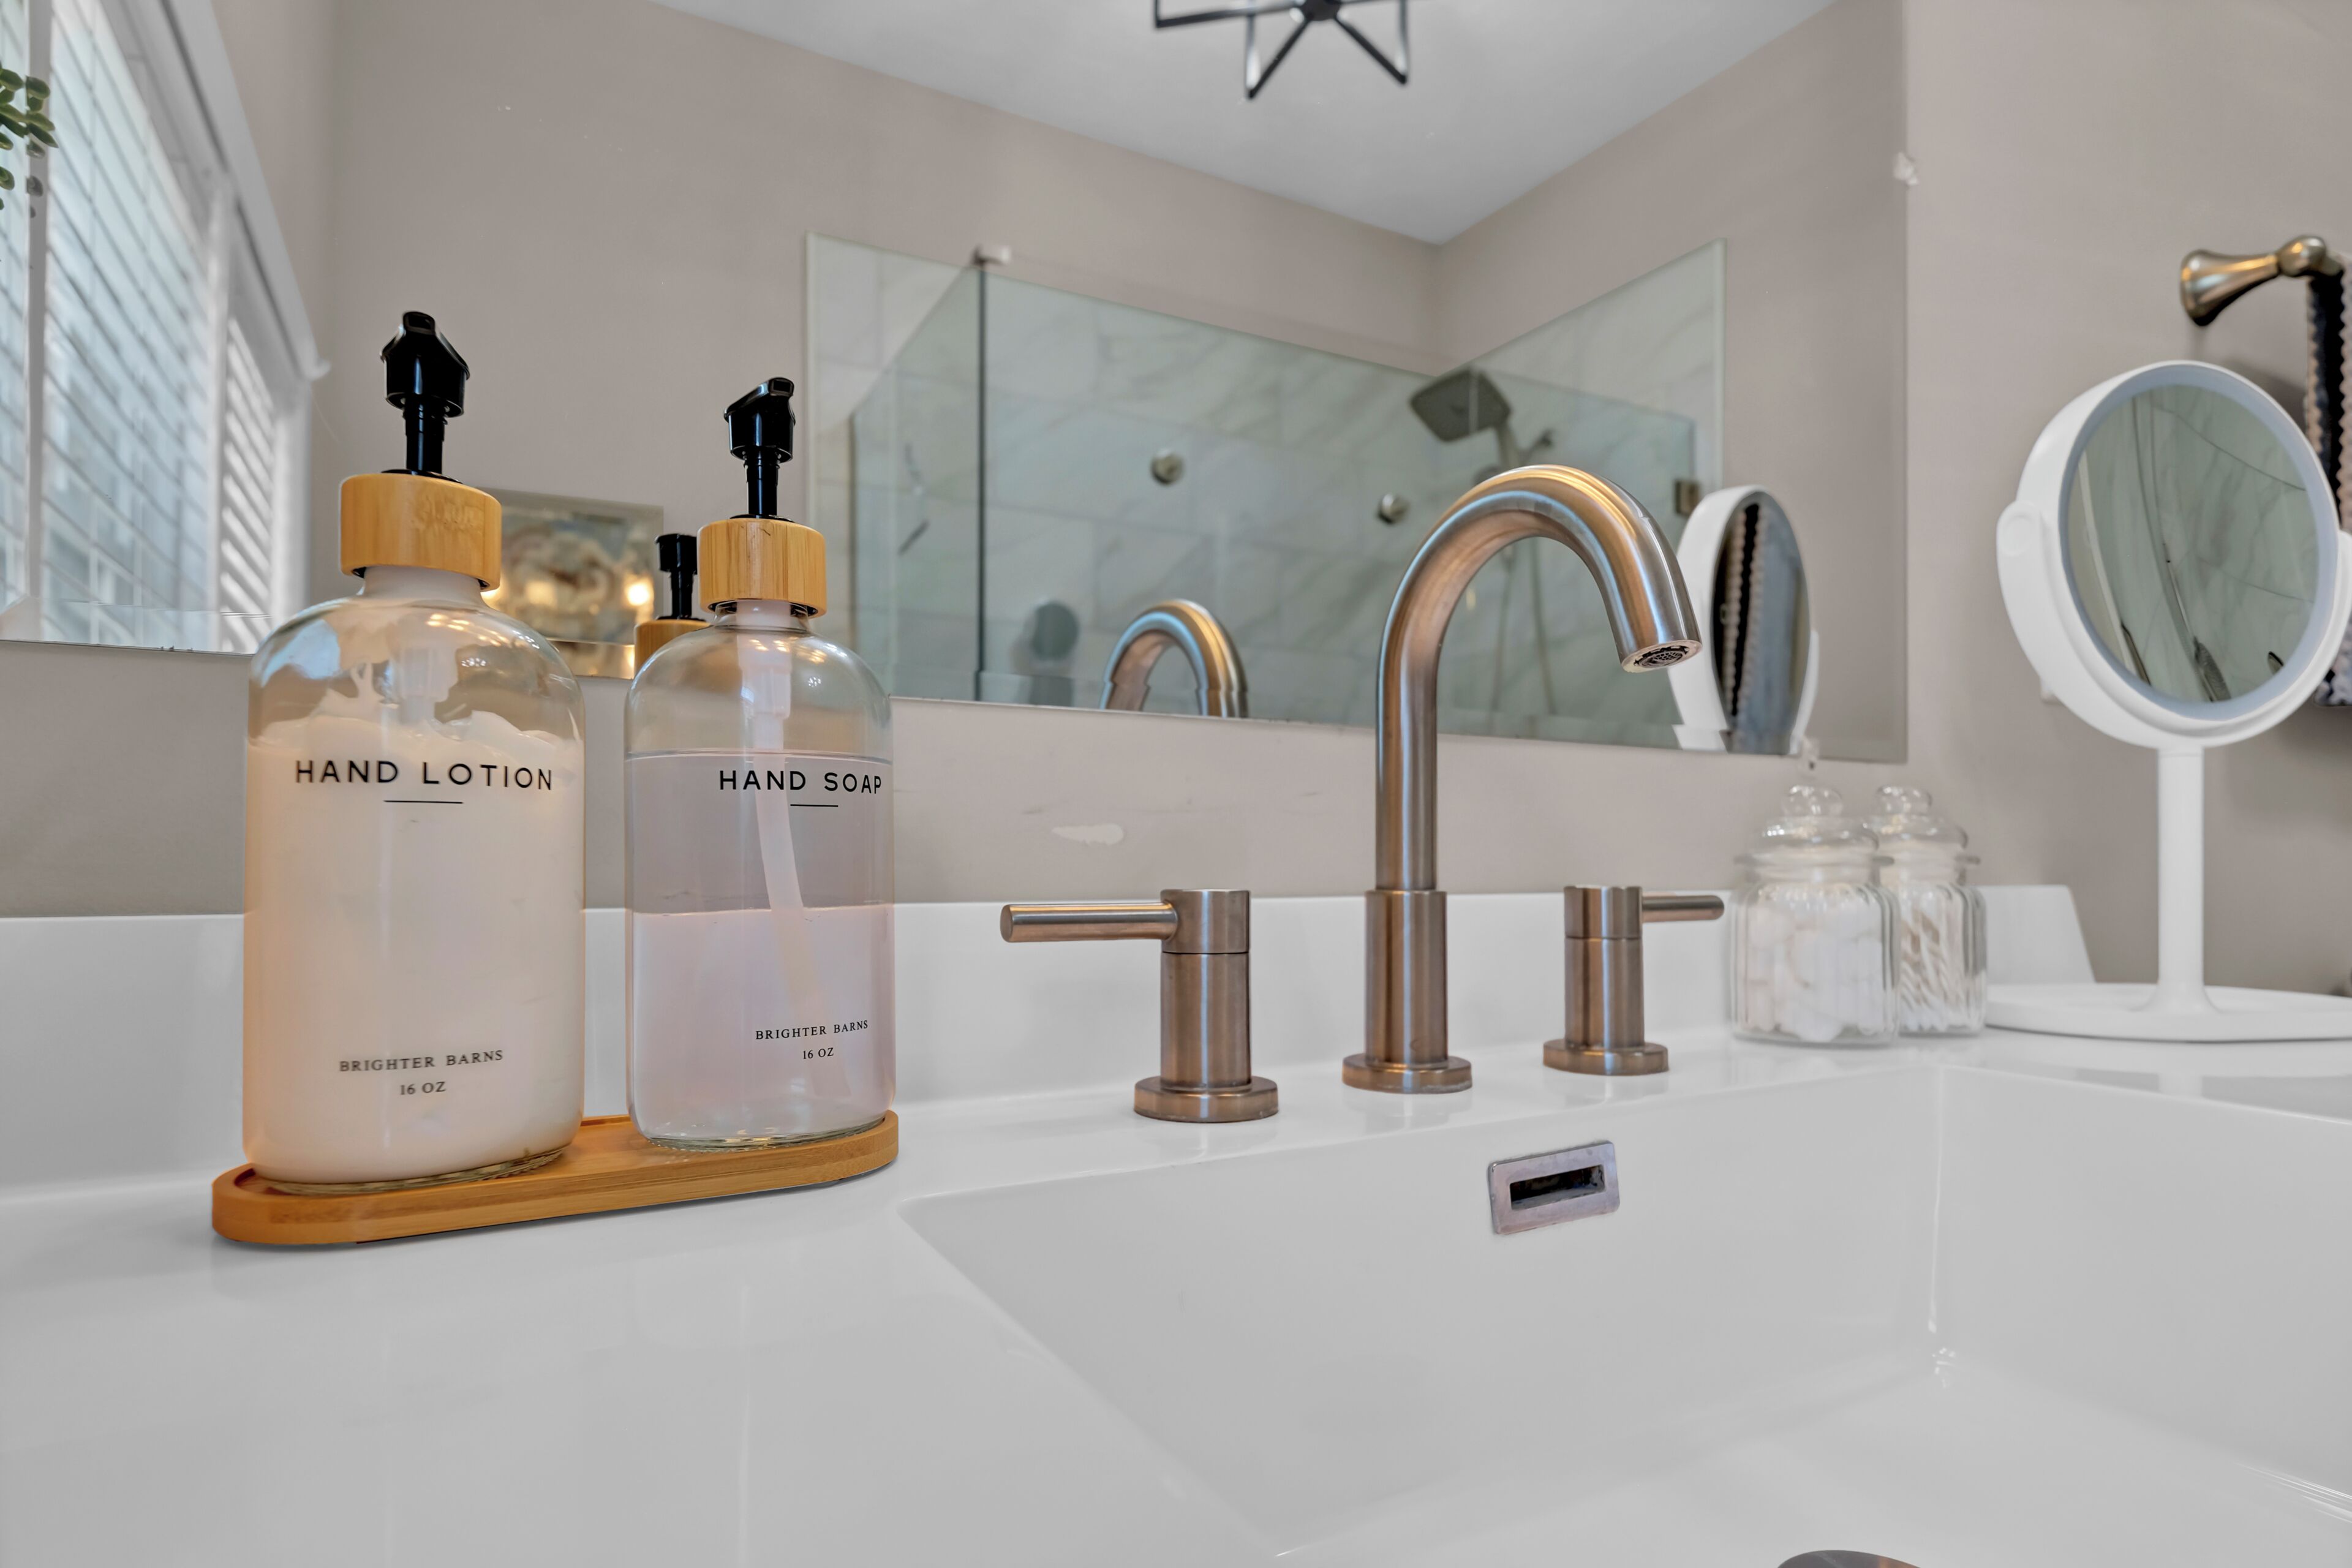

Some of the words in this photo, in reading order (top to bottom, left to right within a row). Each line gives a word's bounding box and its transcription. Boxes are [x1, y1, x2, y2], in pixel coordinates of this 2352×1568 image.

[296, 760, 399, 783] HAND
[423, 762, 551, 790] LOTION
[719, 770, 806, 790] HAND
[824, 772, 881, 794] SOAP
[756, 1026, 827, 1039] BRIGHTER
[834, 1020, 868, 1033] BARNS
[339, 1057, 435, 1072] BRIGHTER
[446, 1050, 503, 1066] BARNS
[803, 1050, 813, 1060] 16
[818, 1047, 834, 1058] OZ
[400, 1084, 416, 1095] 16
[422, 1081, 447, 1093] OZ
